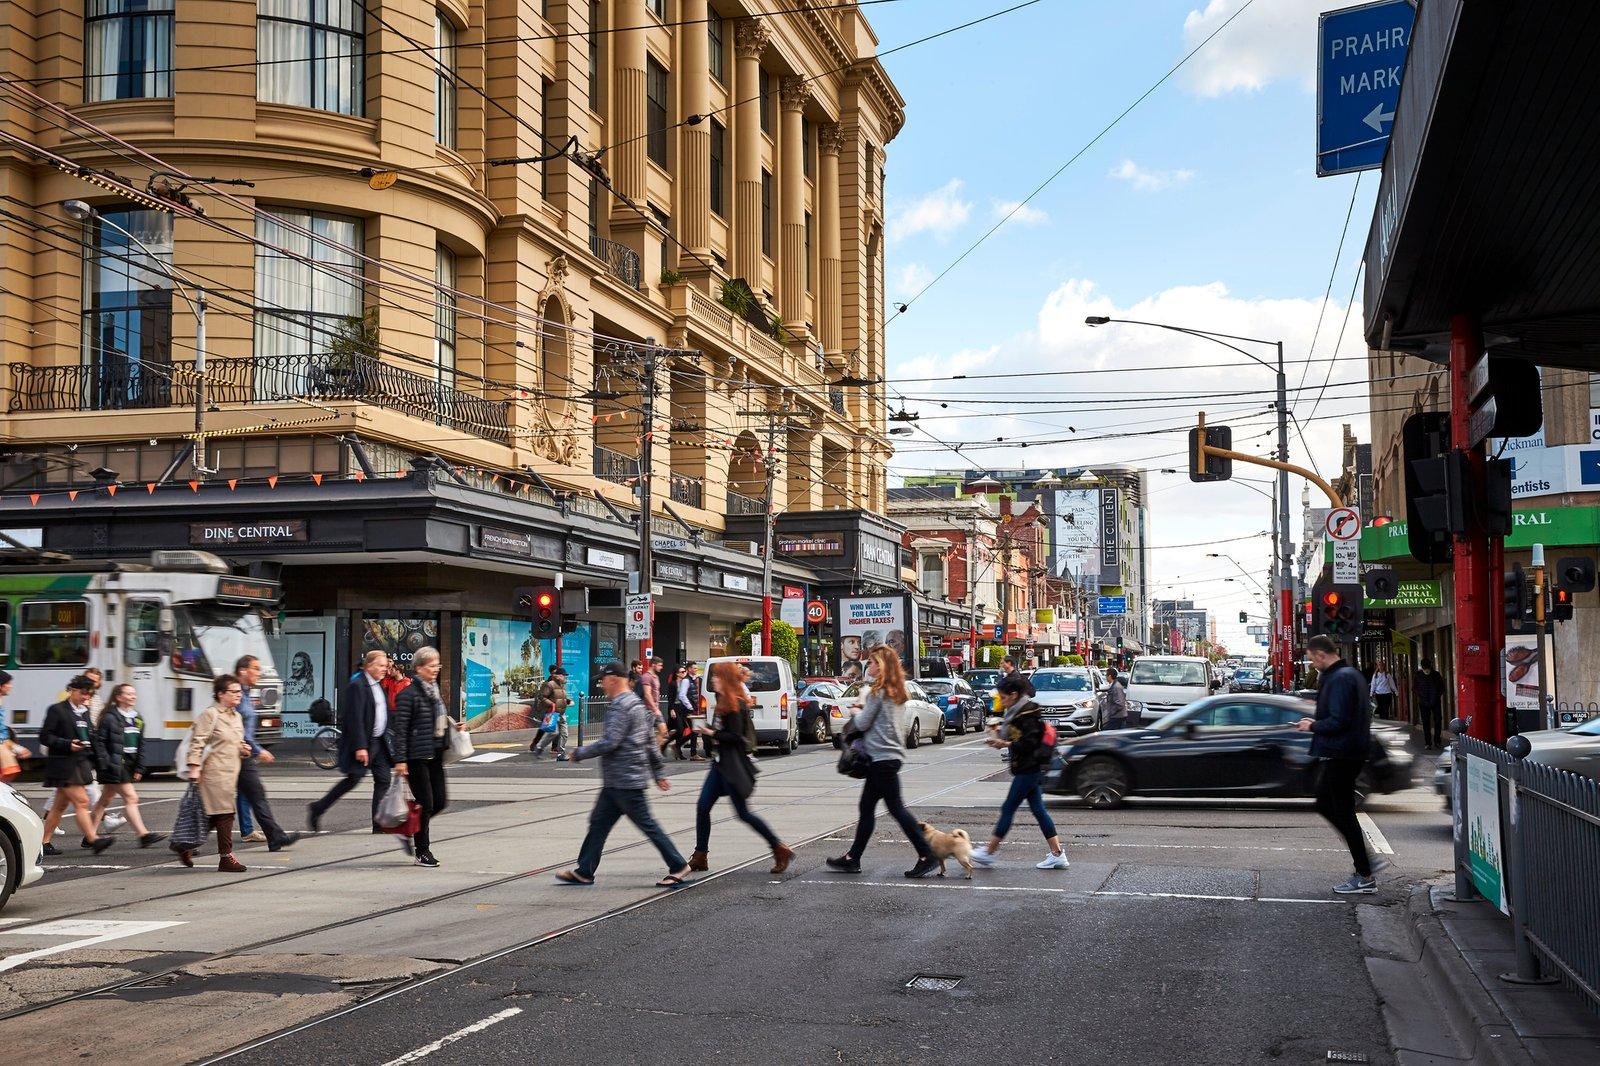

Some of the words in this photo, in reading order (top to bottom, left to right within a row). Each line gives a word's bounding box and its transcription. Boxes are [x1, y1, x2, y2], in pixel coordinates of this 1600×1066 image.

[1332, 28, 1410, 59] PRAHR
[1106, 496, 1114, 535] CULLEN
[1512, 512, 1552, 526] RAL
[204, 528, 234, 538] DINE
[238, 526, 293, 538] CENTRAL
[484, 534, 501, 542] FRENCH
[502, 537, 528, 548] CONNECTION
[1106, 540, 1114, 558] THE
[808, 607, 823, 617] 40
[400, 652, 416, 660] CO
